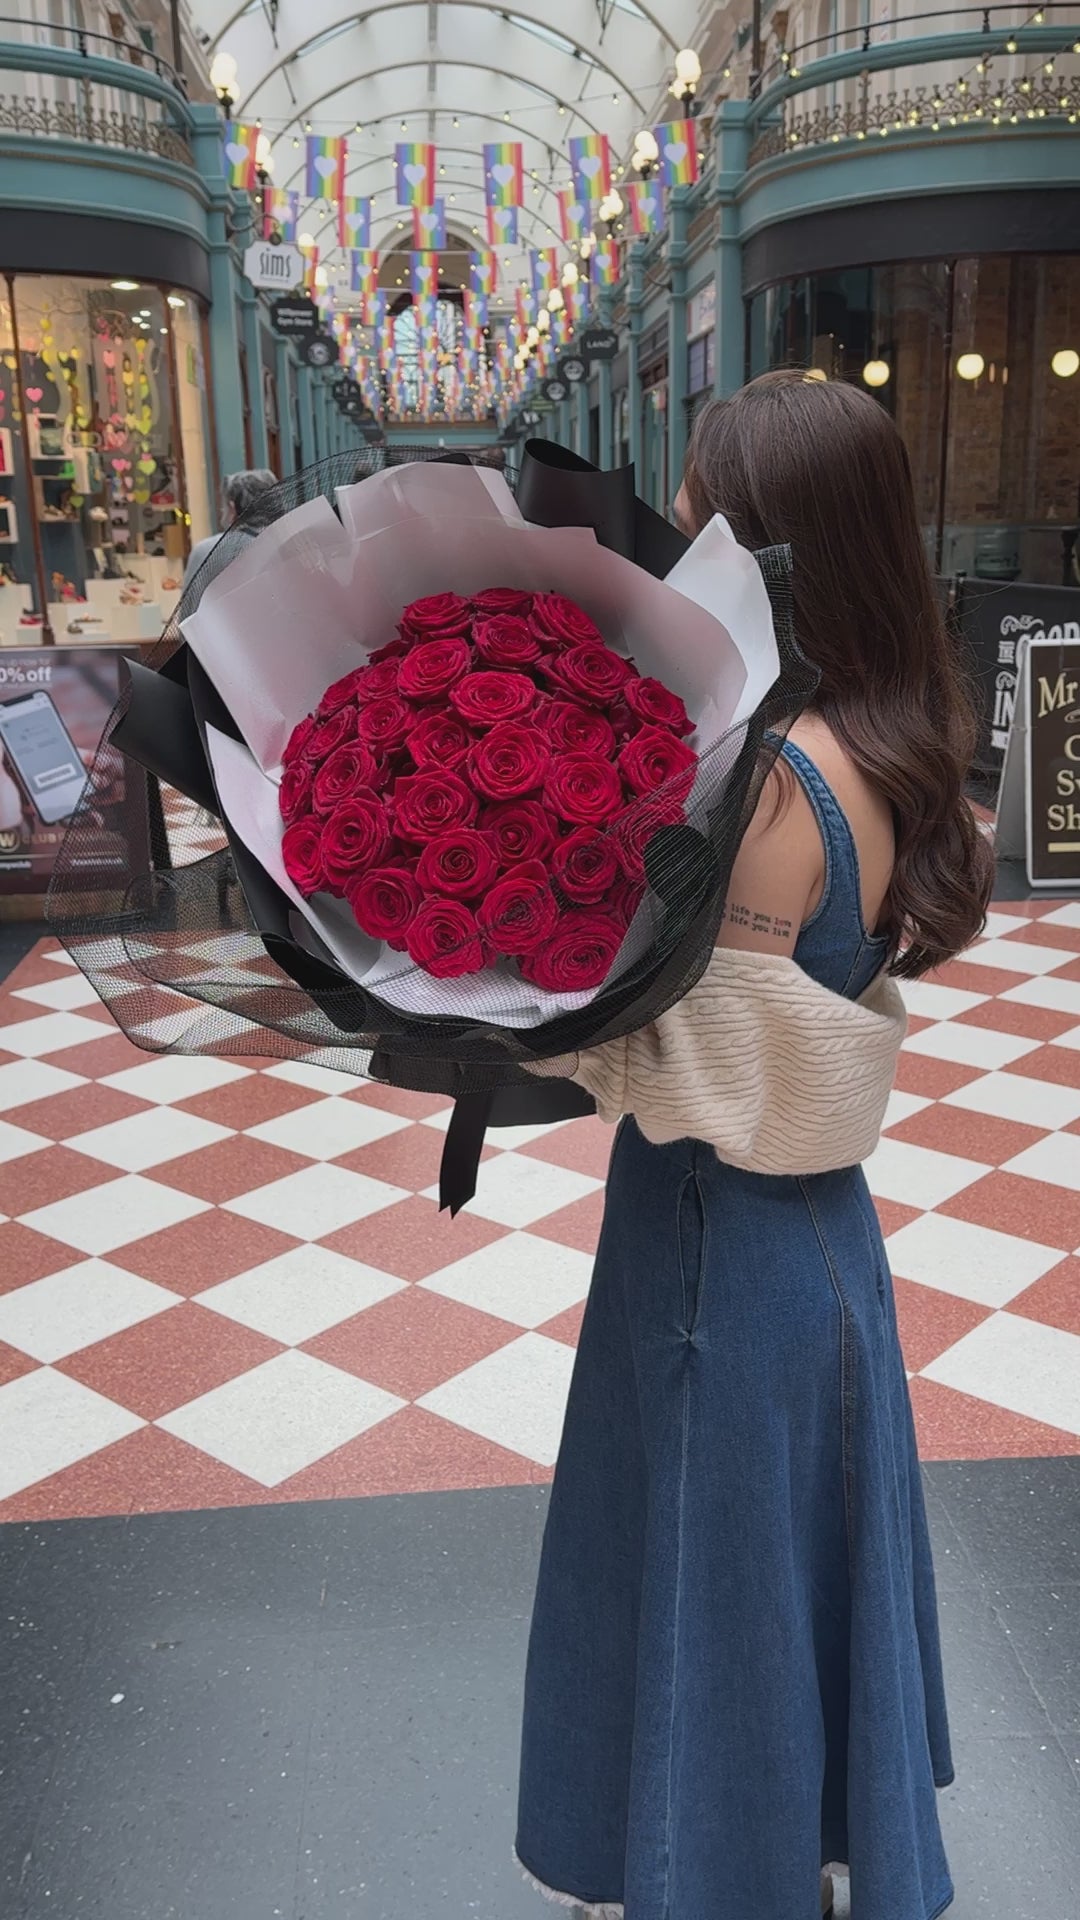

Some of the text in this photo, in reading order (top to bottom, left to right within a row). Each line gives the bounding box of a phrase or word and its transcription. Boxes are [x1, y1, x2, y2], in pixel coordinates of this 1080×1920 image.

[260, 247, 291, 278] sims
[1038, 672, 1079, 718] Mr
[729, 914, 748, 926] life
[751, 923, 769, 934] you
[731, 903, 750, 915] life
[753, 911, 771, 923] you
